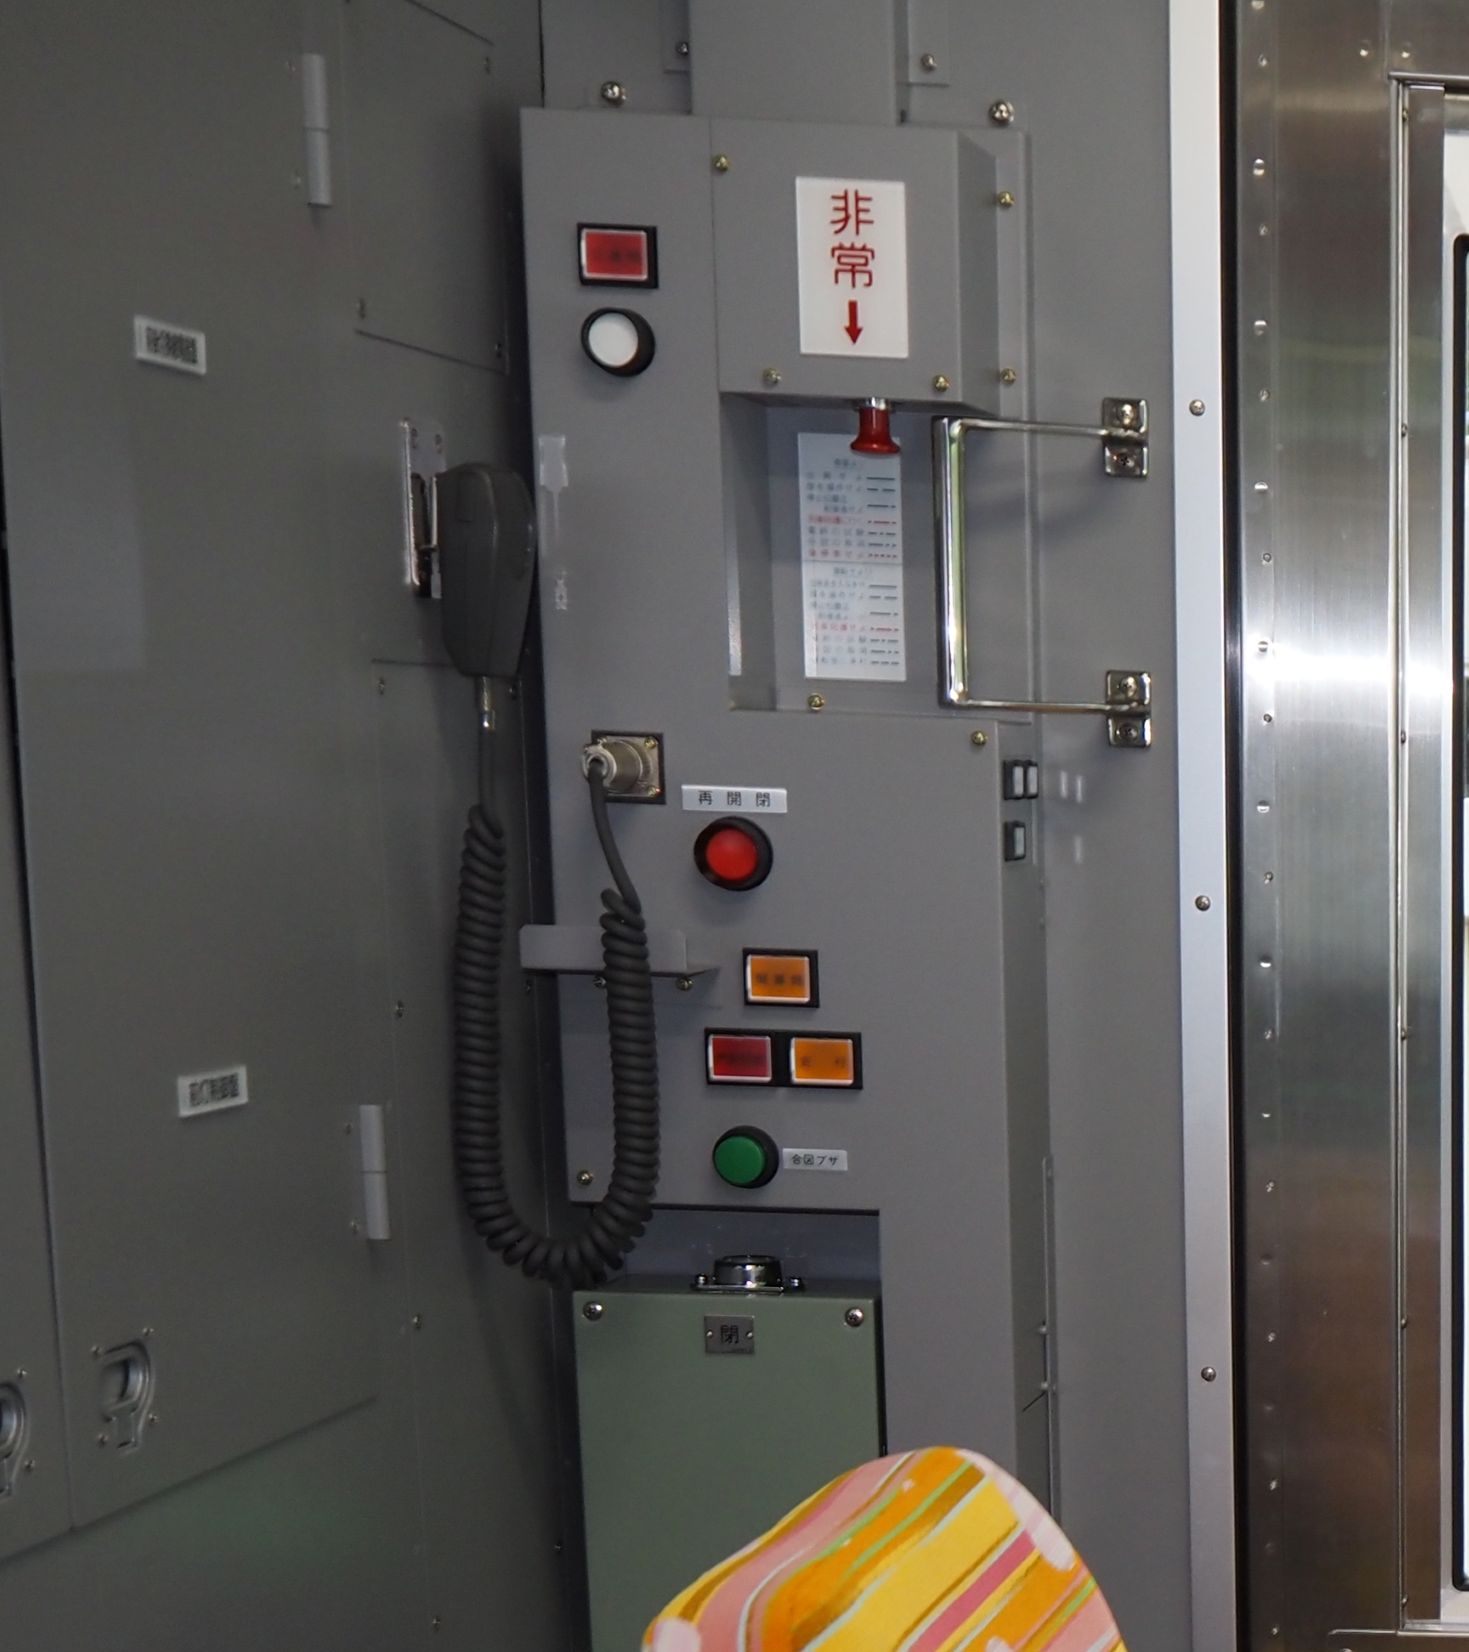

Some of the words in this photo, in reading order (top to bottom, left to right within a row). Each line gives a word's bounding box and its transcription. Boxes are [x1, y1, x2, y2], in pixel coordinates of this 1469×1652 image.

[829, 188, 876, 289] 非常
[698, 790, 770, 807] 再開閉
[720, 1324, 740, 1344] 閉
